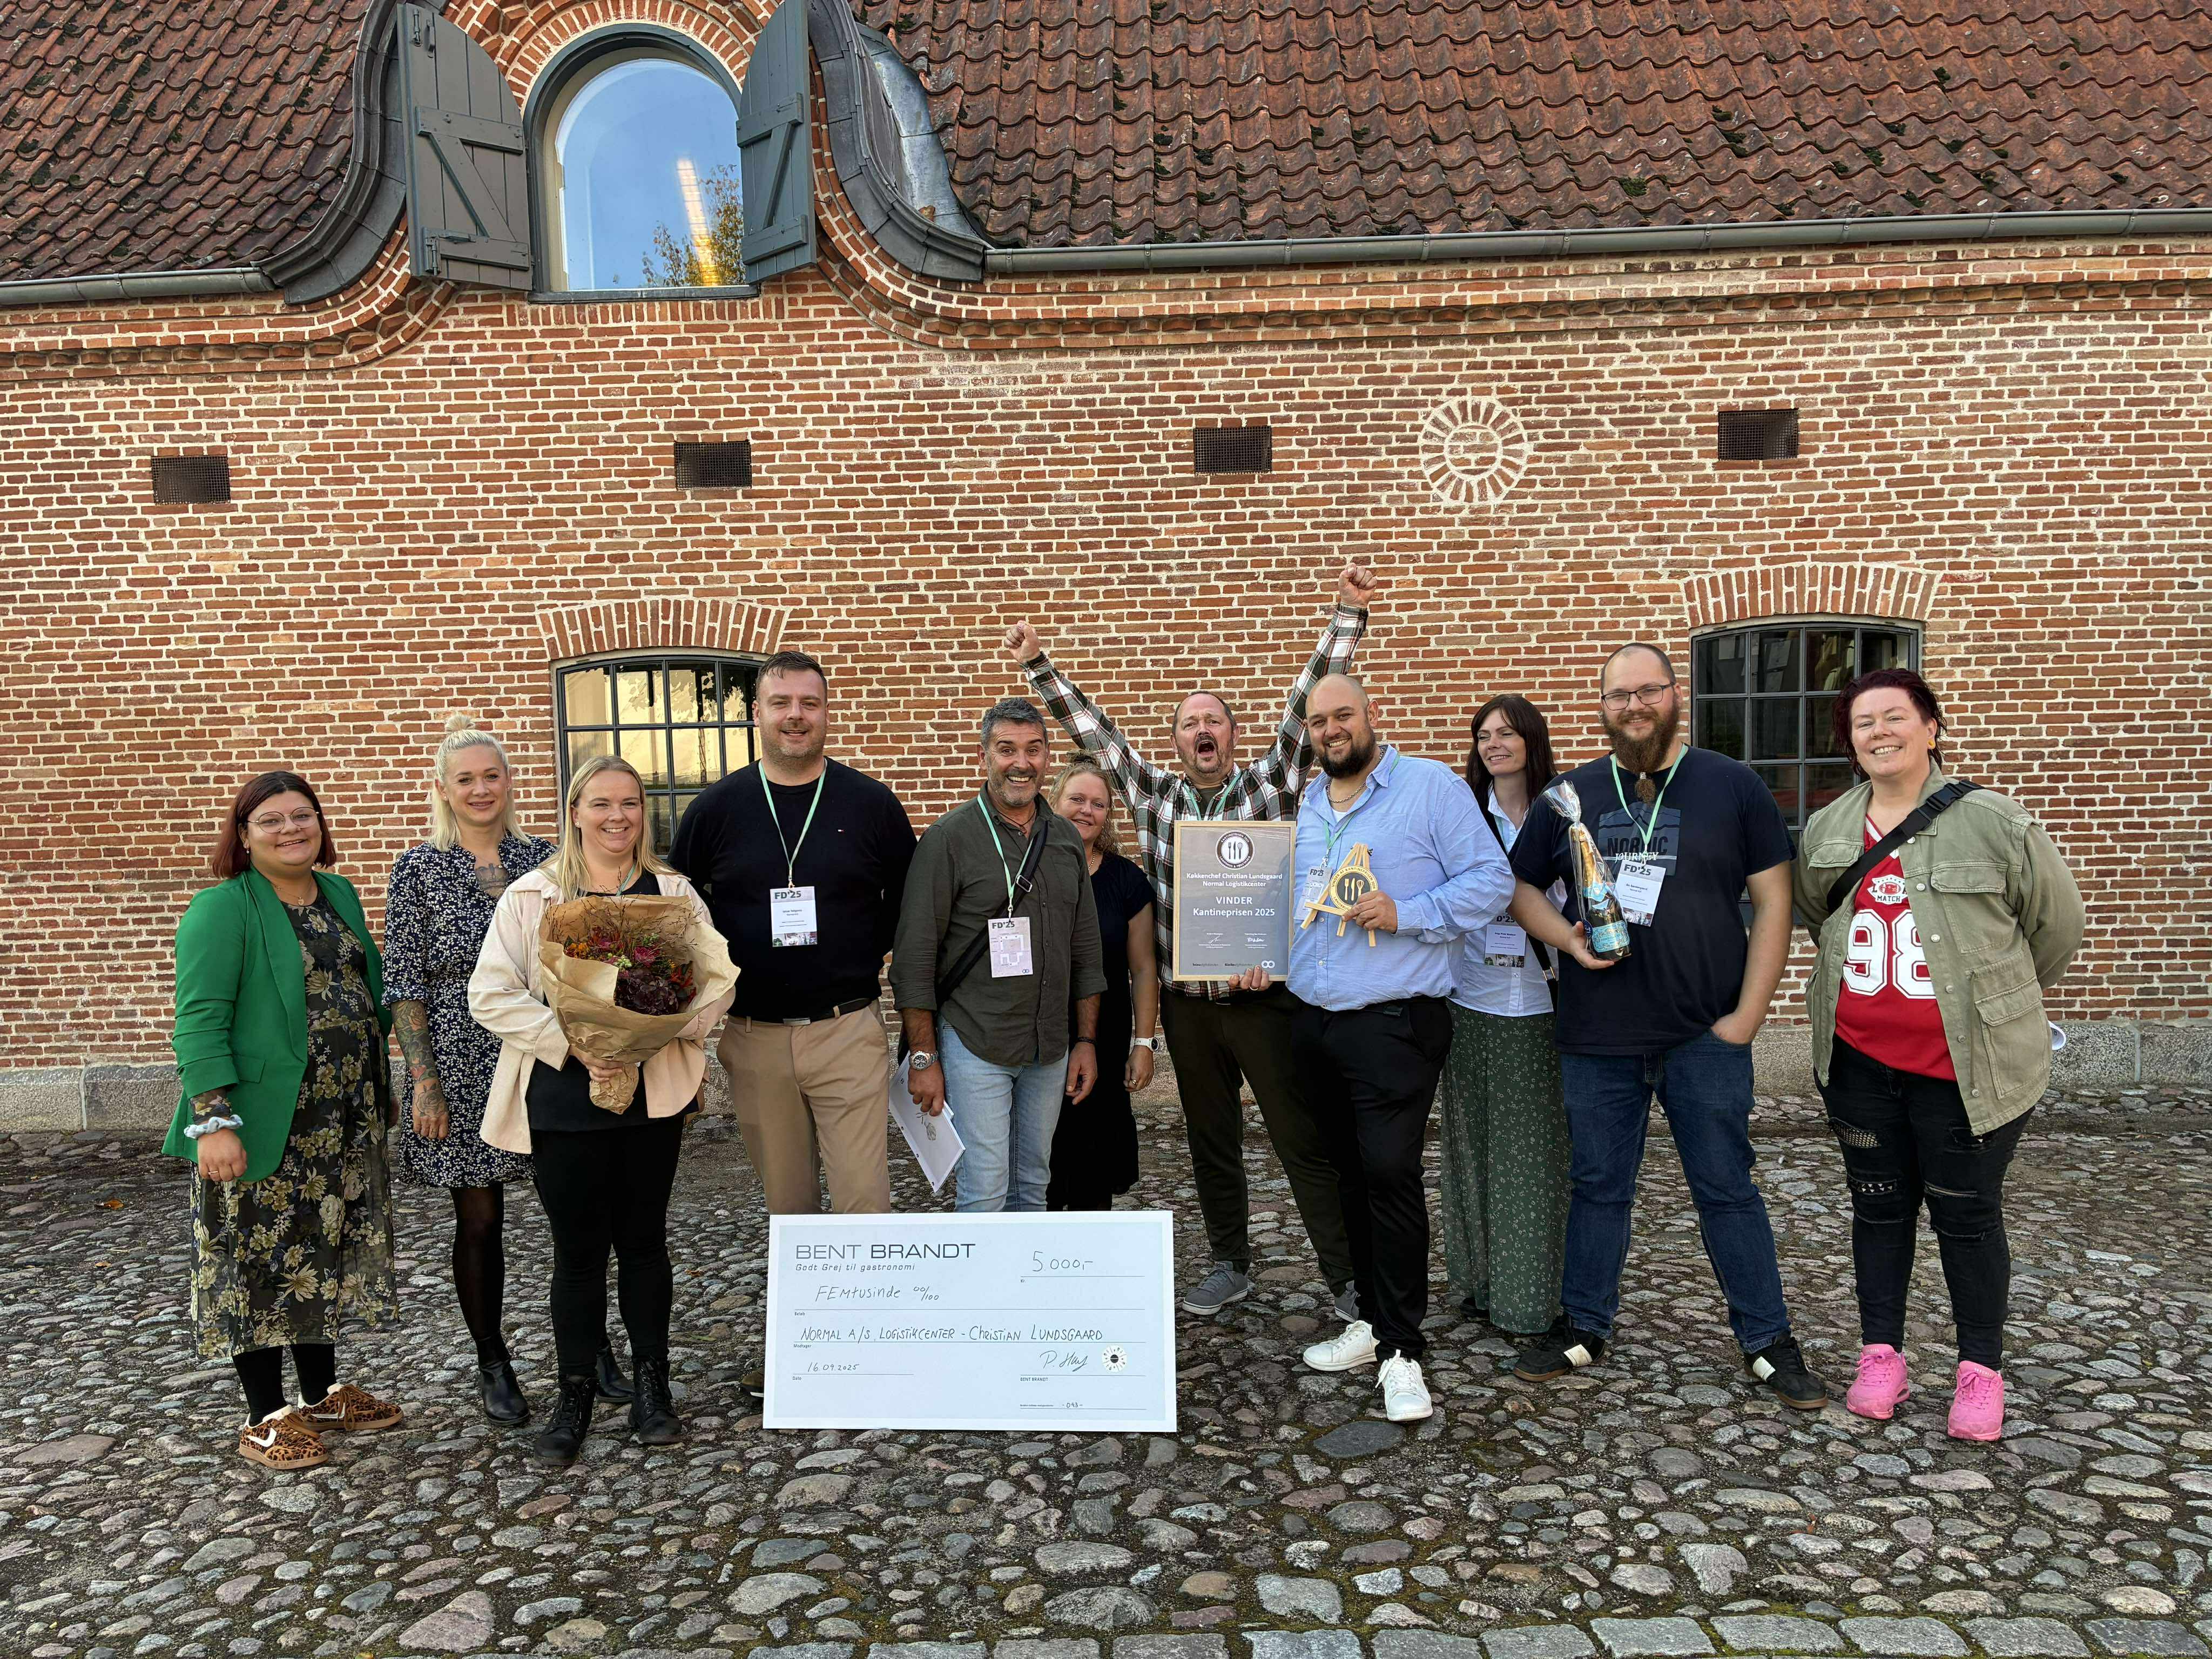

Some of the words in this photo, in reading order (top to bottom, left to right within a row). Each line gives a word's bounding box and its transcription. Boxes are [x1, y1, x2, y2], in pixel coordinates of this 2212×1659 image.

[1624, 864, 1651, 875] FD'25
[774, 891, 801, 899] FD'25
[1193, 908, 1253, 918] Kantineprisen
[1843, 909, 1937, 999] 98
[796, 1244, 861, 1259] BENT
[871, 1244, 976, 1259] BRANDT
[821, 1264, 841, 1272] Grej
[860, 1263, 915, 1272] gastronomi
[801, 1326, 841, 1341] NORMAL
[1031, 1324, 1103, 1341] LUNDSGAARD
